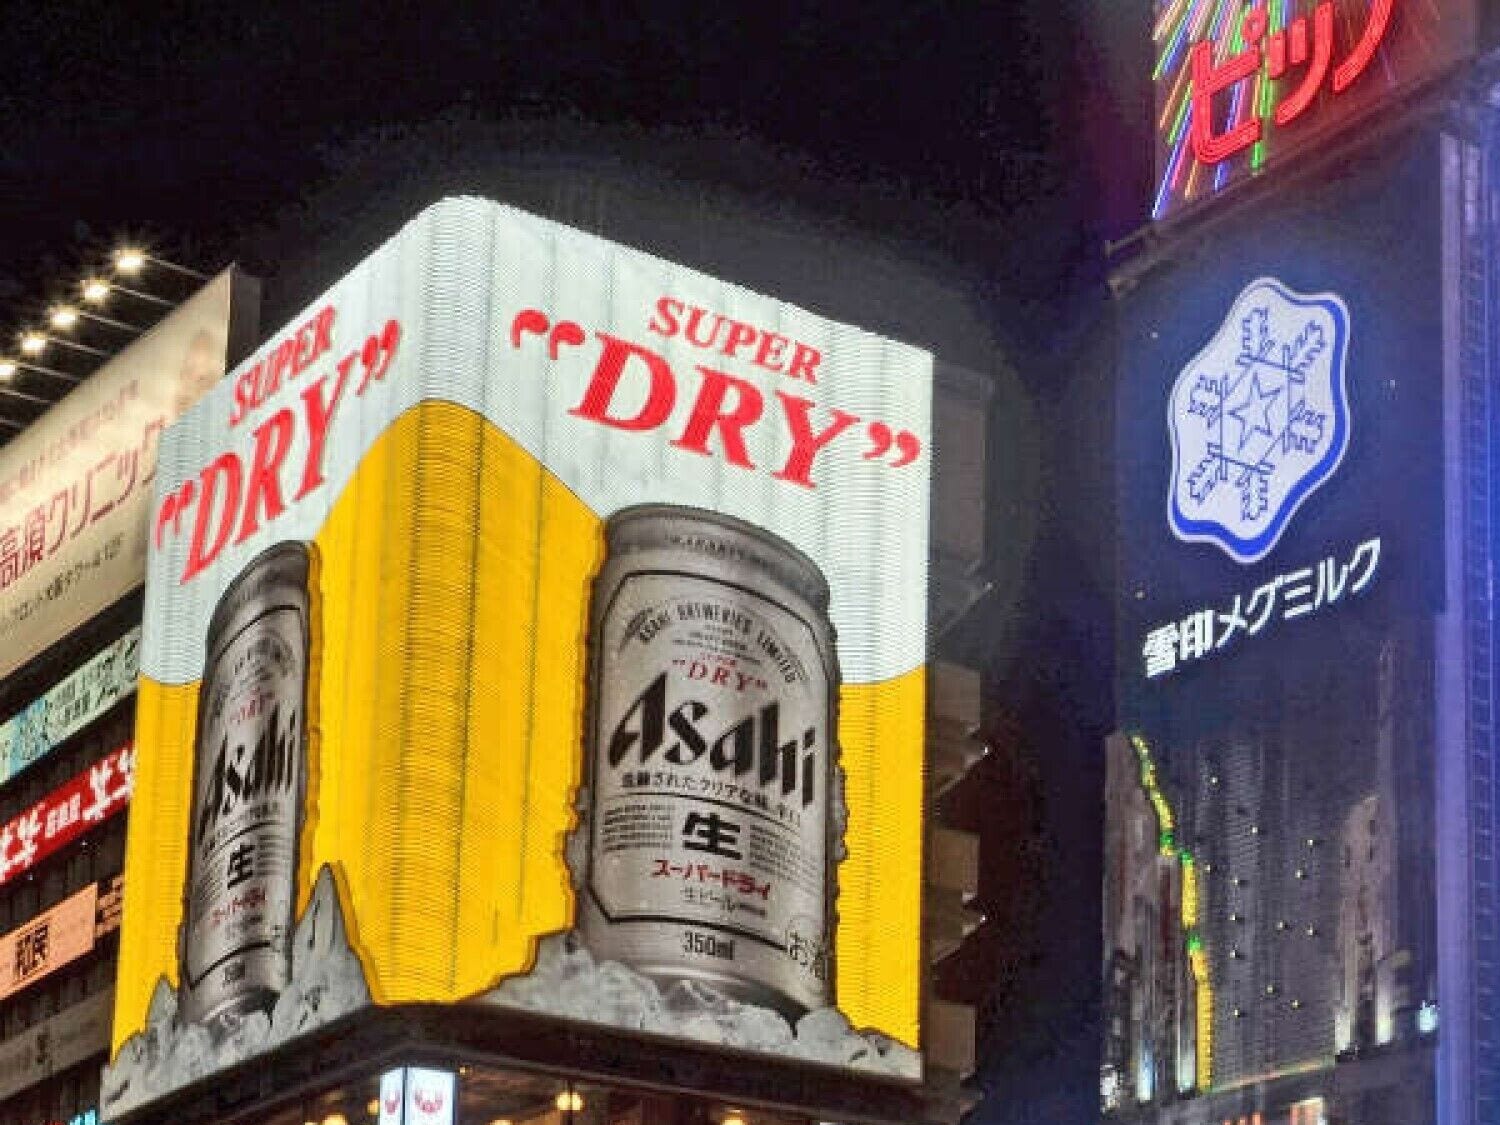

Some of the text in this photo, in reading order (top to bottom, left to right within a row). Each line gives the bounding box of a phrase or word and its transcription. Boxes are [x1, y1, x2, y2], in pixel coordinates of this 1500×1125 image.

[228, 305, 336, 427] SUPER
[649, 297, 823, 385] SUPER
[1142, 537, 1380, 678] 雪印メグミルク
[608, 671, 815, 810] Asahi
[226, 843, 254, 889] 生
[682, 812, 743, 860] 生
[682, 931, 735, 961] 350ml
